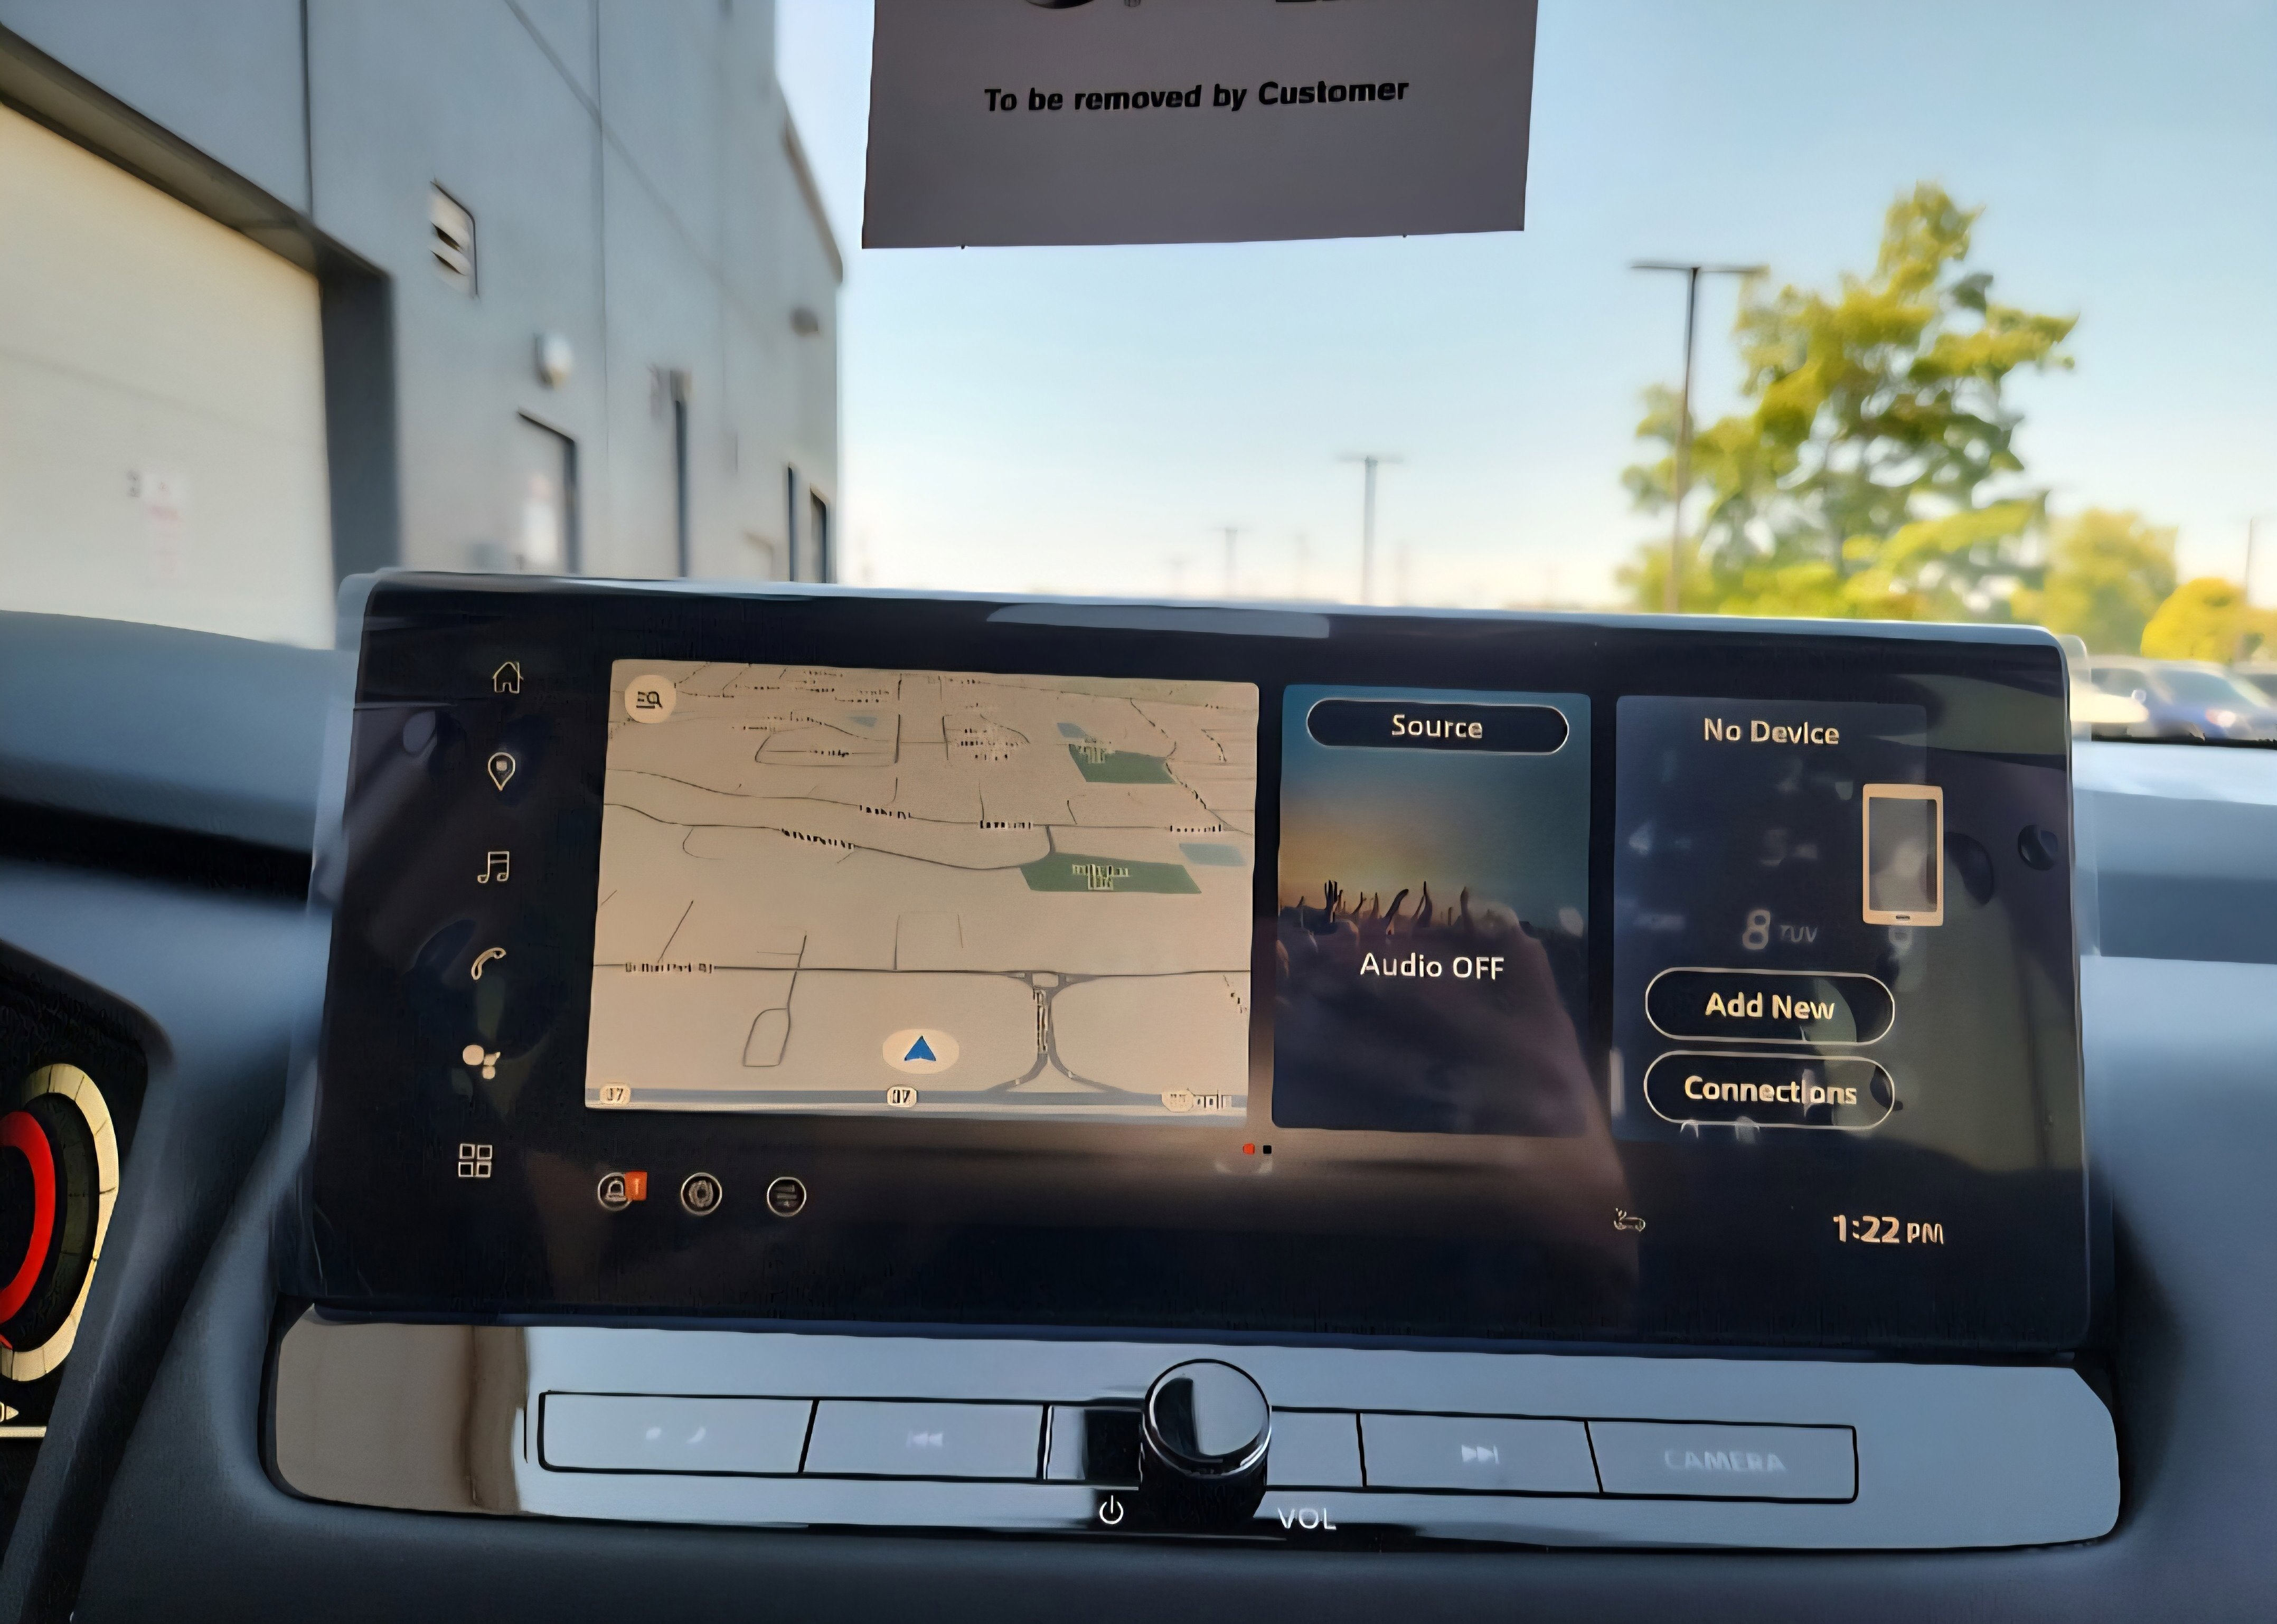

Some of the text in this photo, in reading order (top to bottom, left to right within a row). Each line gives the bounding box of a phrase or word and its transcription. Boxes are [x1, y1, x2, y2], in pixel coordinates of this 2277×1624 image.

[984, 80, 1409, 112] To be removed by Customer
[1391, 714, 1483, 739] Source
[1704, 718, 1840, 745] No Device
[1360, 952, 1504, 980] Audio OFF
[1705, 992, 1835, 1019] Add New
[1685, 1075, 1857, 1104] Connections
[1833, 1214, 1944, 1245] 1:22 PM
[1664, 1451, 1787, 1471] CAMERA
[1277, 1508, 1337, 1530] VOL
